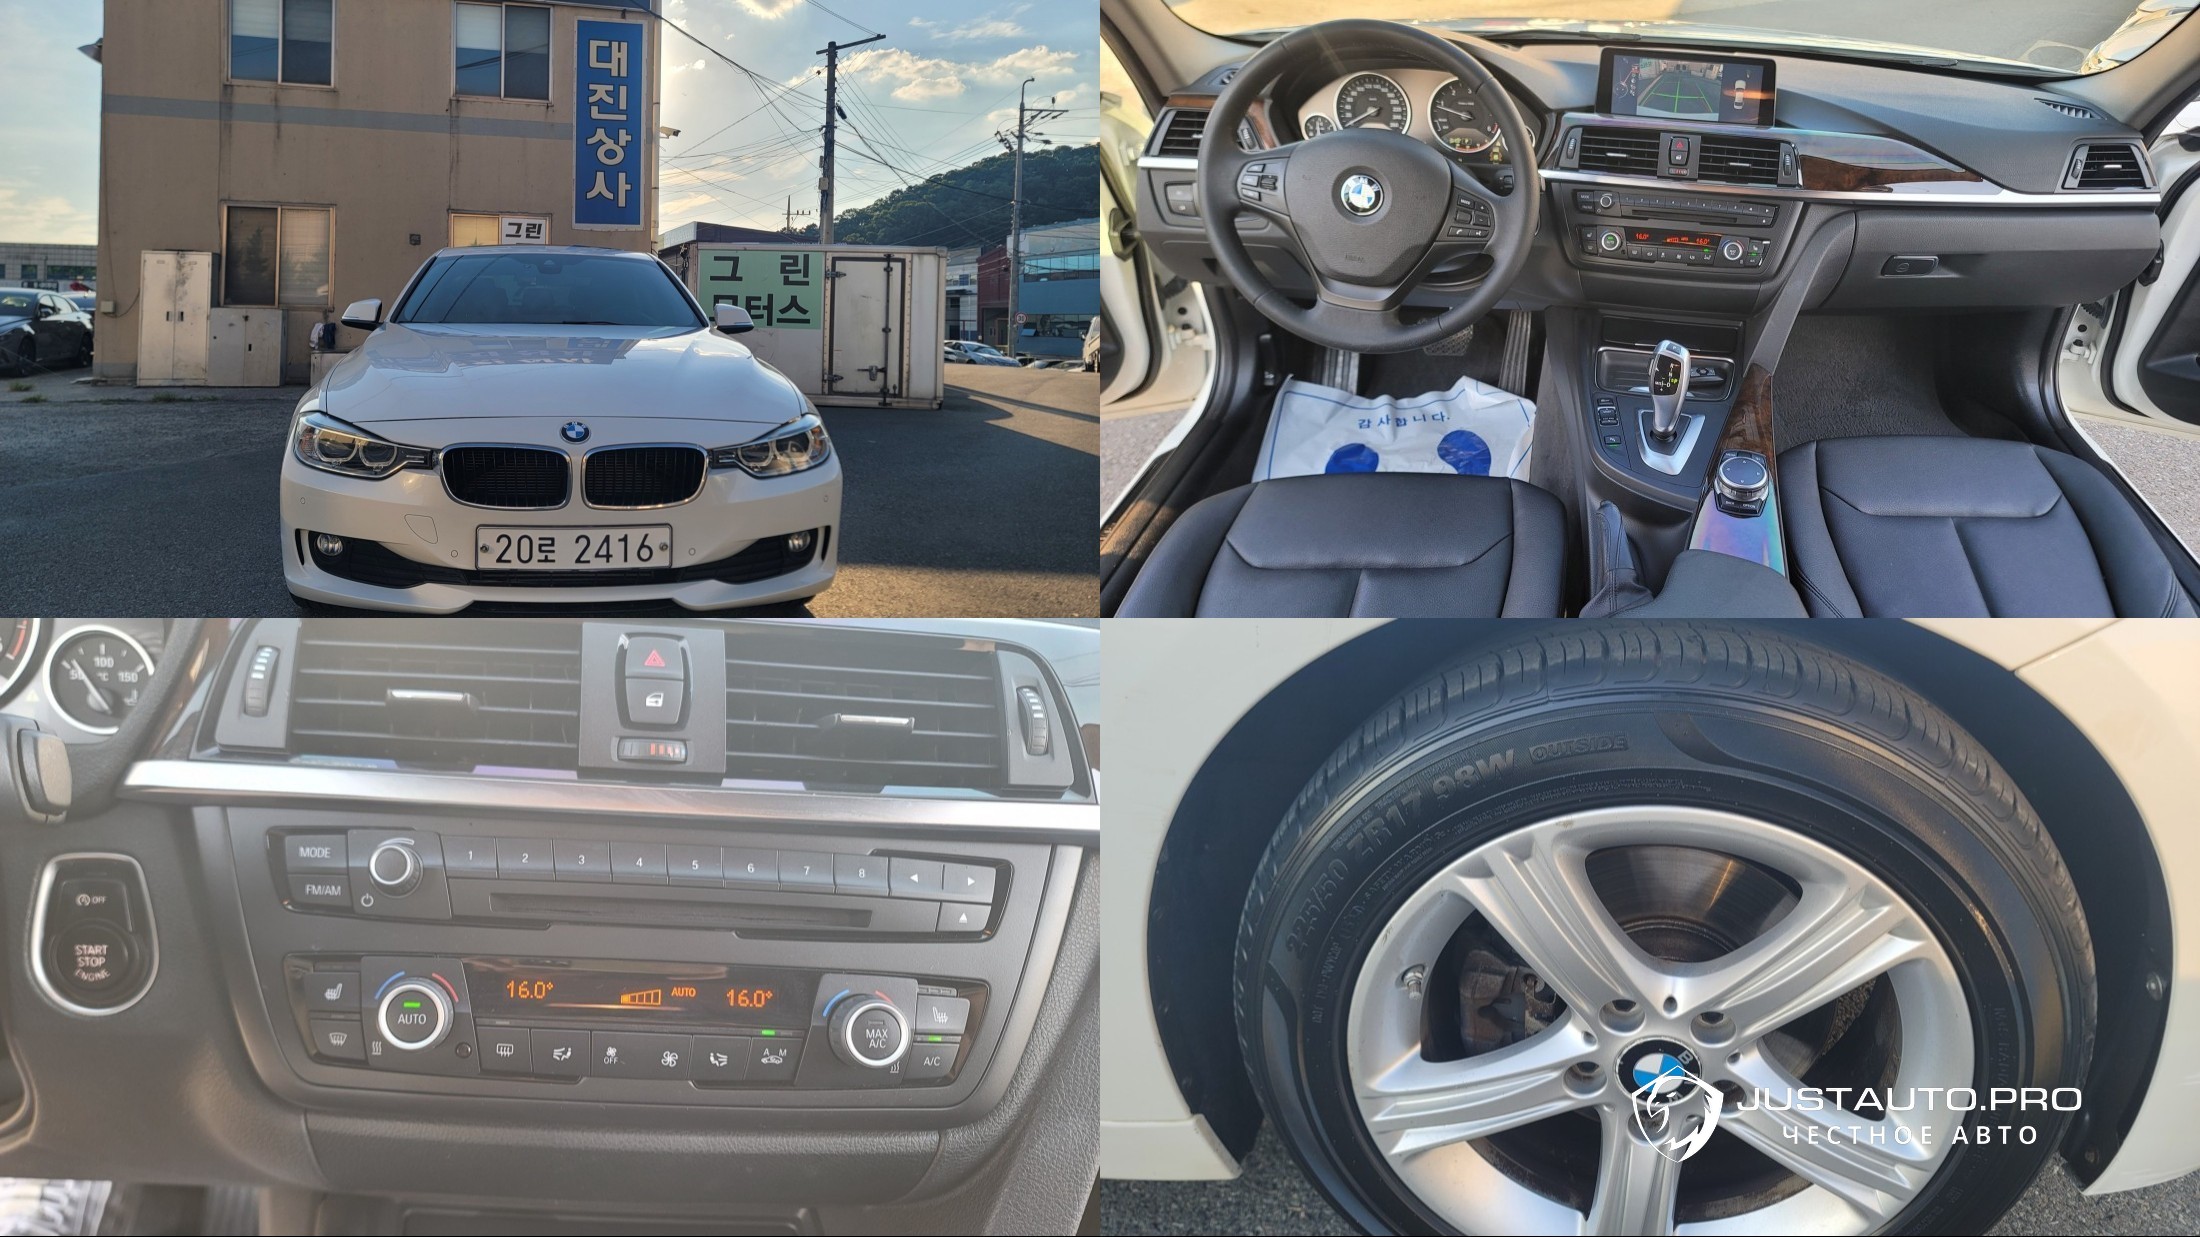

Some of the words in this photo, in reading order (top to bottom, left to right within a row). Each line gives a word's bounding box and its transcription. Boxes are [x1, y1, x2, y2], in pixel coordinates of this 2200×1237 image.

[586, 39, 632, 208] 대진상사
[505, 222, 542, 239] 그린
[495, 534, 556, 564] 20로
[574, 533, 654, 564] 2416
[94, 657, 114, 668] 100
[118, 673, 138, 682] 150
[1433, 749, 1515, 801] 98W
[1531, 735, 1628, 763] OUTSIDE
[299, 847, 331, 858] MODE
[468, 850, 473, 860] 1
[522, 853, 529, 863] 2
[578, 855, 585, 865] 3
[636, 857, 643, 867] 4
[692, 860, 699, 870] 5
[747, 863, 754, 873] 6
[804, 866, 810, 876] 7
[858, 868, 865, 878] 8
[305, 885, 341, 896] FM/AM
[92, 896, 106, 904] OFF
[75, 944, 108, 955] START
[78, 956, 106, 967] STOP
[74, 968, 111, 981] ENGINE
[506, 980, 554, 999] 16.0°
[671, 987, 697, 998] AUTO
[726, 988, 773, 1008] 16.0°
[397, 1013, 427, 1025] AUTO
[866, 1029, 888, 1039] MAX
[869, 1039, 886, 1049] A/C
[763, 1048, 770, 1056] A
[779, 1048, 787, 1057] M
[603, 1057, 618, 1065] OFF
[923, 1057, 941, 1066] A/C
